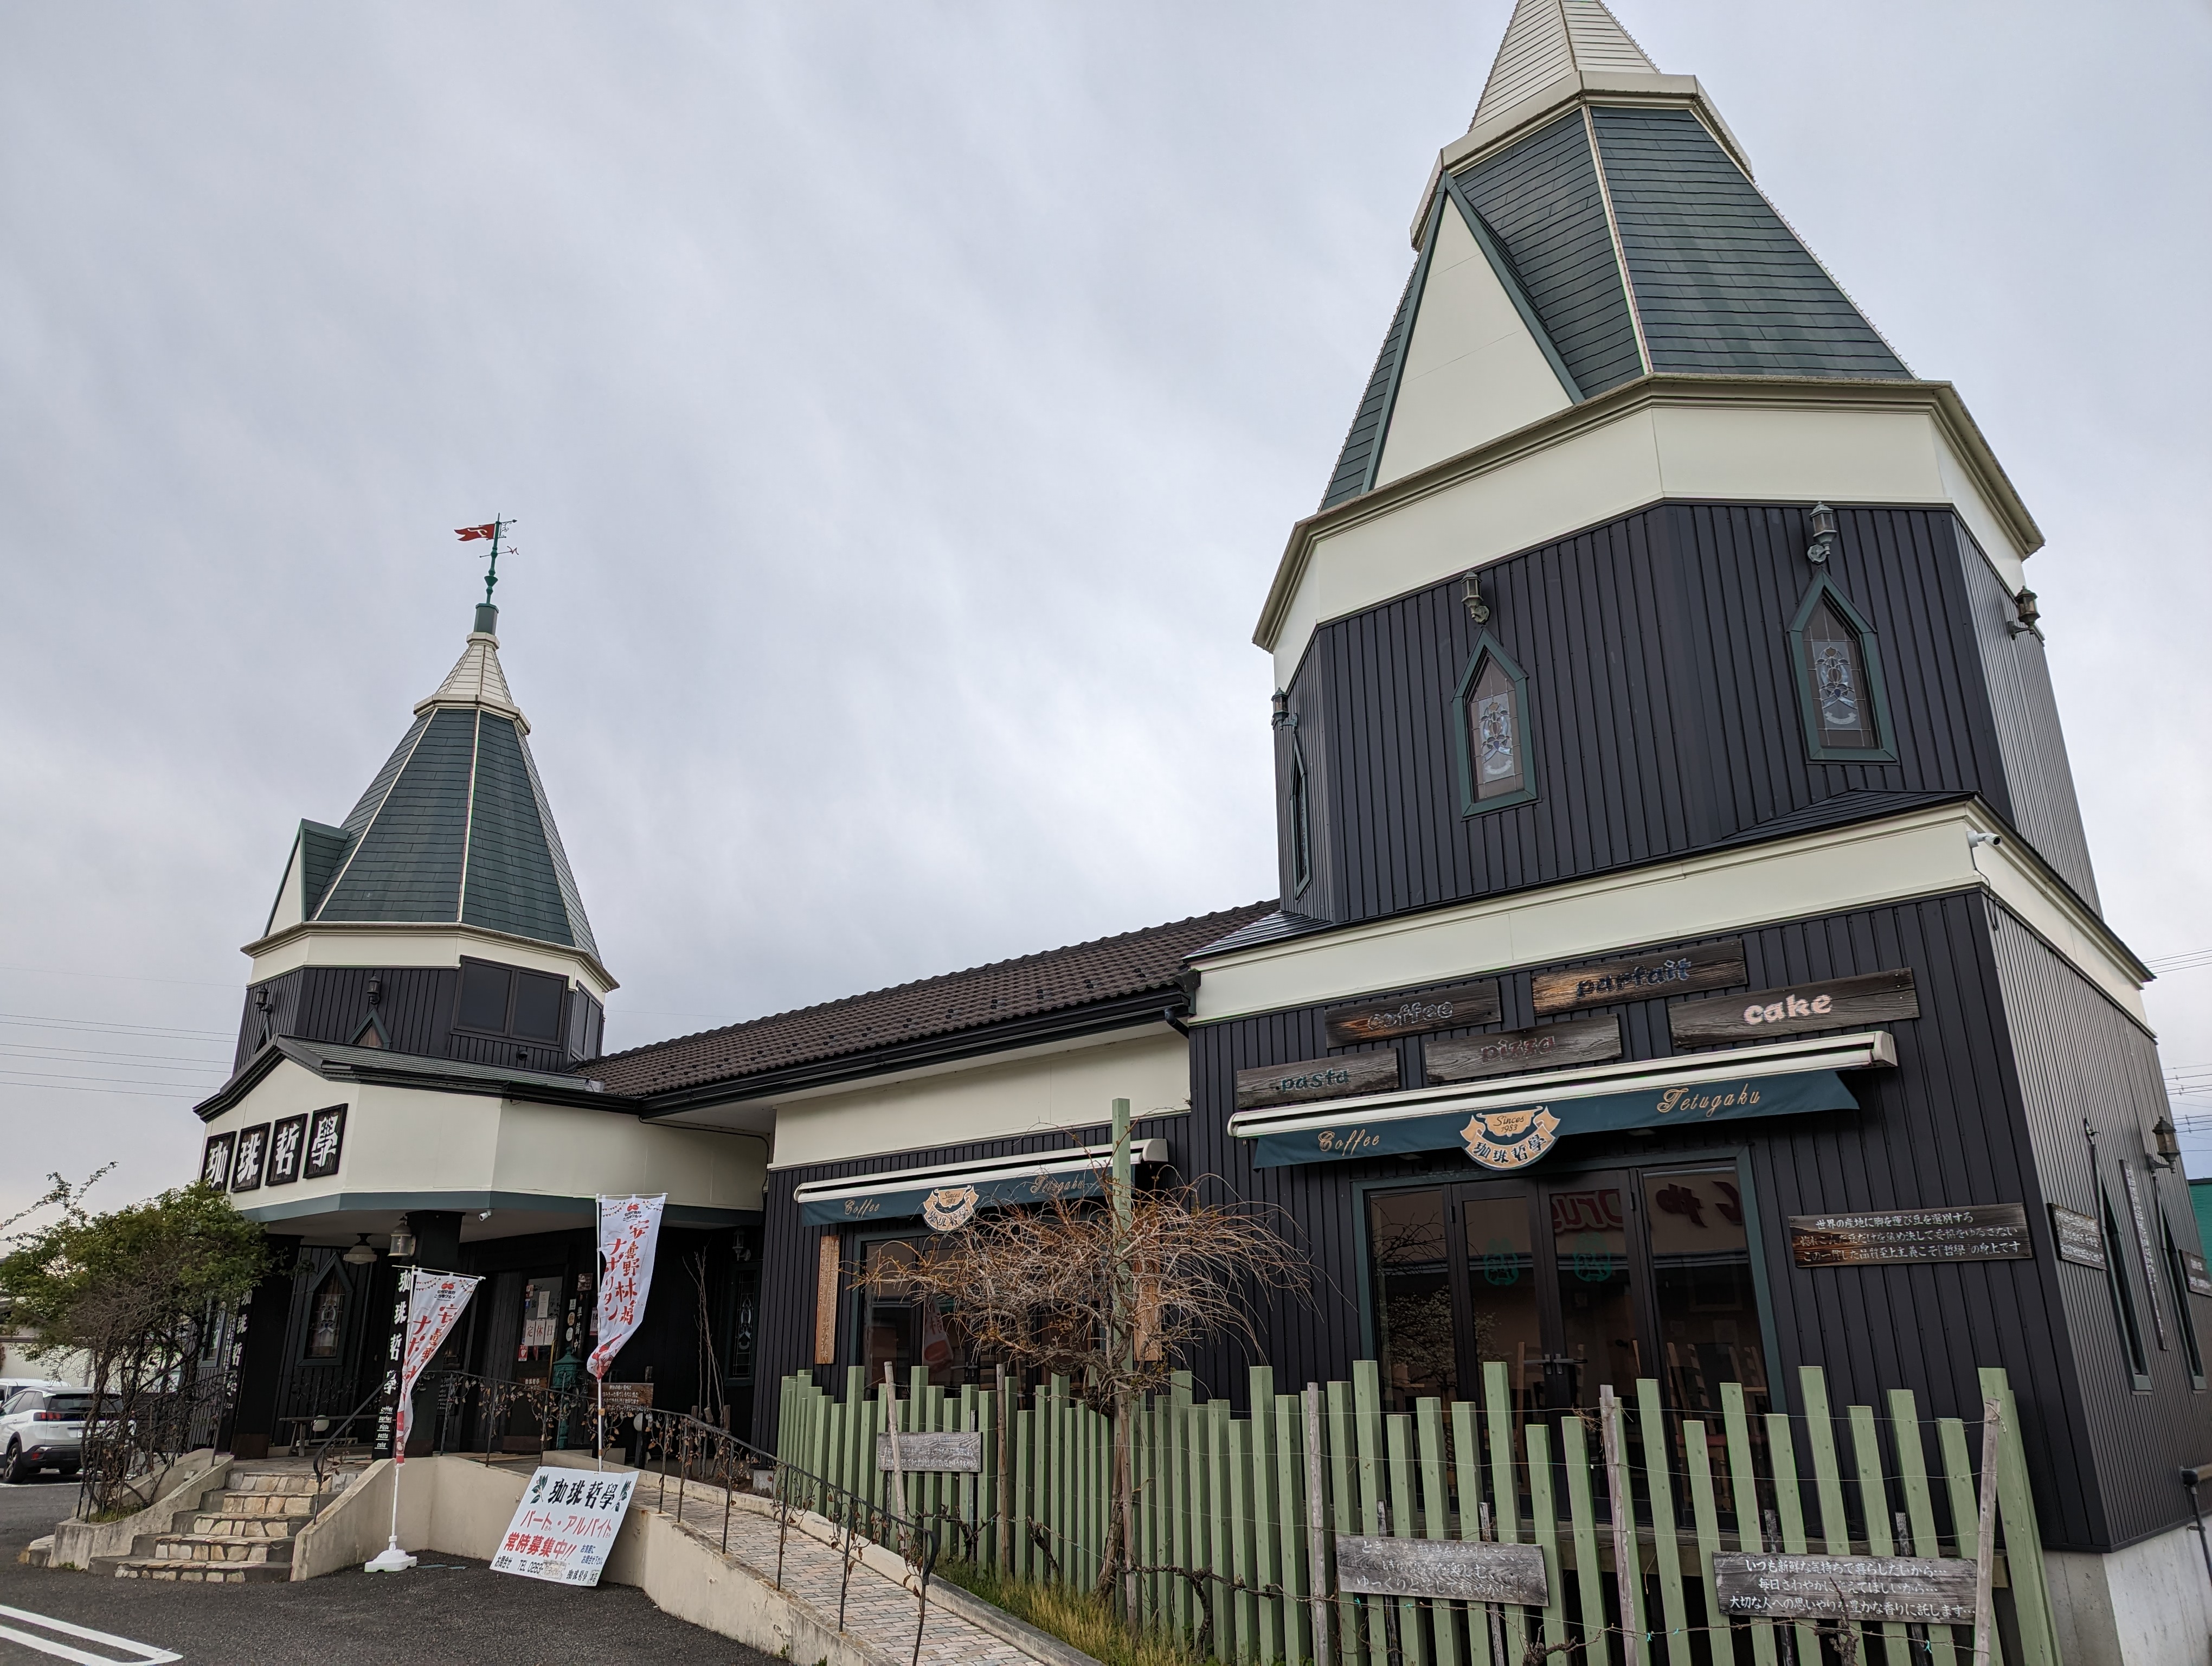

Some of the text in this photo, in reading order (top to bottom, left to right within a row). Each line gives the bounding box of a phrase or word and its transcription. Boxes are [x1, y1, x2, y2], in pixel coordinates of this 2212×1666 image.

[1576, 958, 1692, 998] parfait
[1367, 1001, 1454, 1030] coffee
[1743, 994, 1832, 1025] cake
[1481, 1035, 1555, 1063] pizza
[1281, 1068, 1350, 1093] pasta
[1656, 1084, 1760, 1117] Tetugaku
[1317, 1130, 1380, 1156] Coffee
[1501, 1124, 1518, 1133] 1983
[1473, 1133, 1548, 1164] 珈琲哲學
[845, 1198, 880, 1219] Coffee
[548, 1478, 619, 1510] 珈琲哲學
